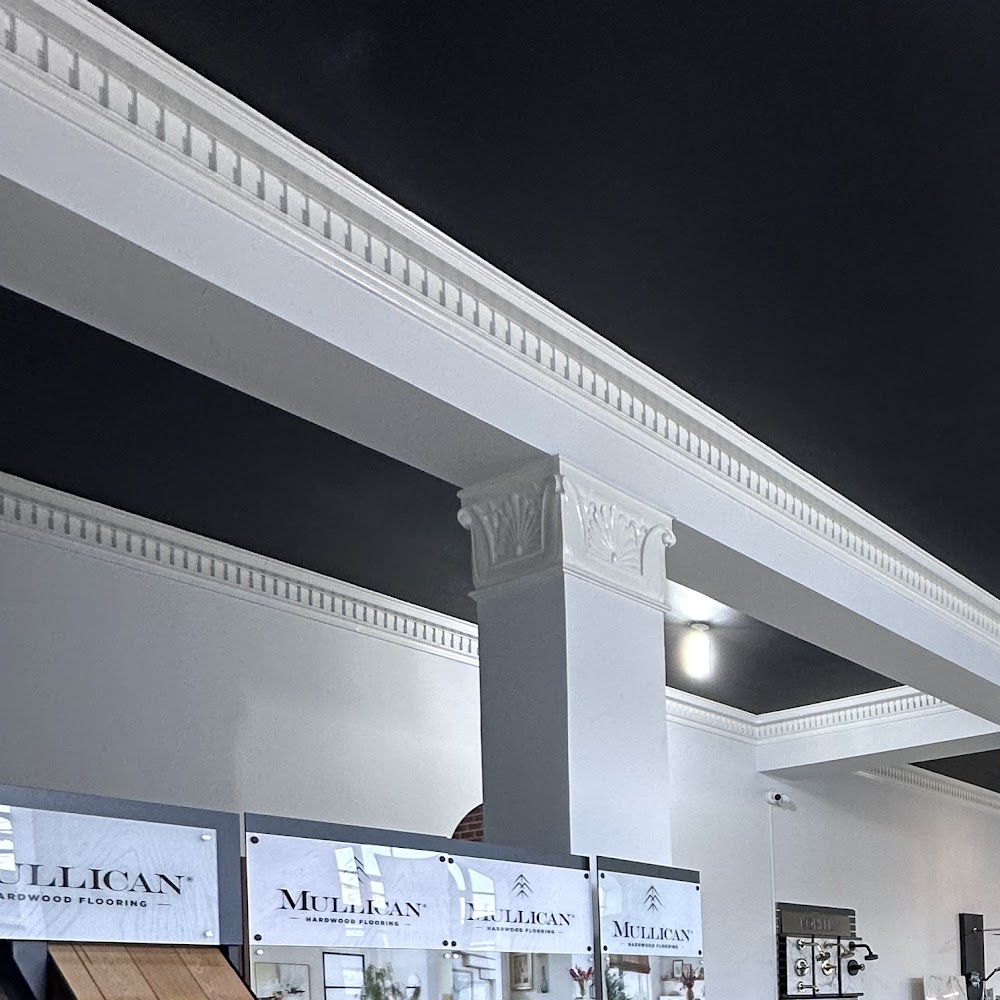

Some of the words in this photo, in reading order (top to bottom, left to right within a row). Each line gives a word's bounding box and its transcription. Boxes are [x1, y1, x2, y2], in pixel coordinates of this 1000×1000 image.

[79, 897, 148, 908] FLOORING
[306, 916, 356, 925] HARDWOOD
[359, 919, 400, 927] FLOORING
[613, 920, 691, 941] MULLICAN
